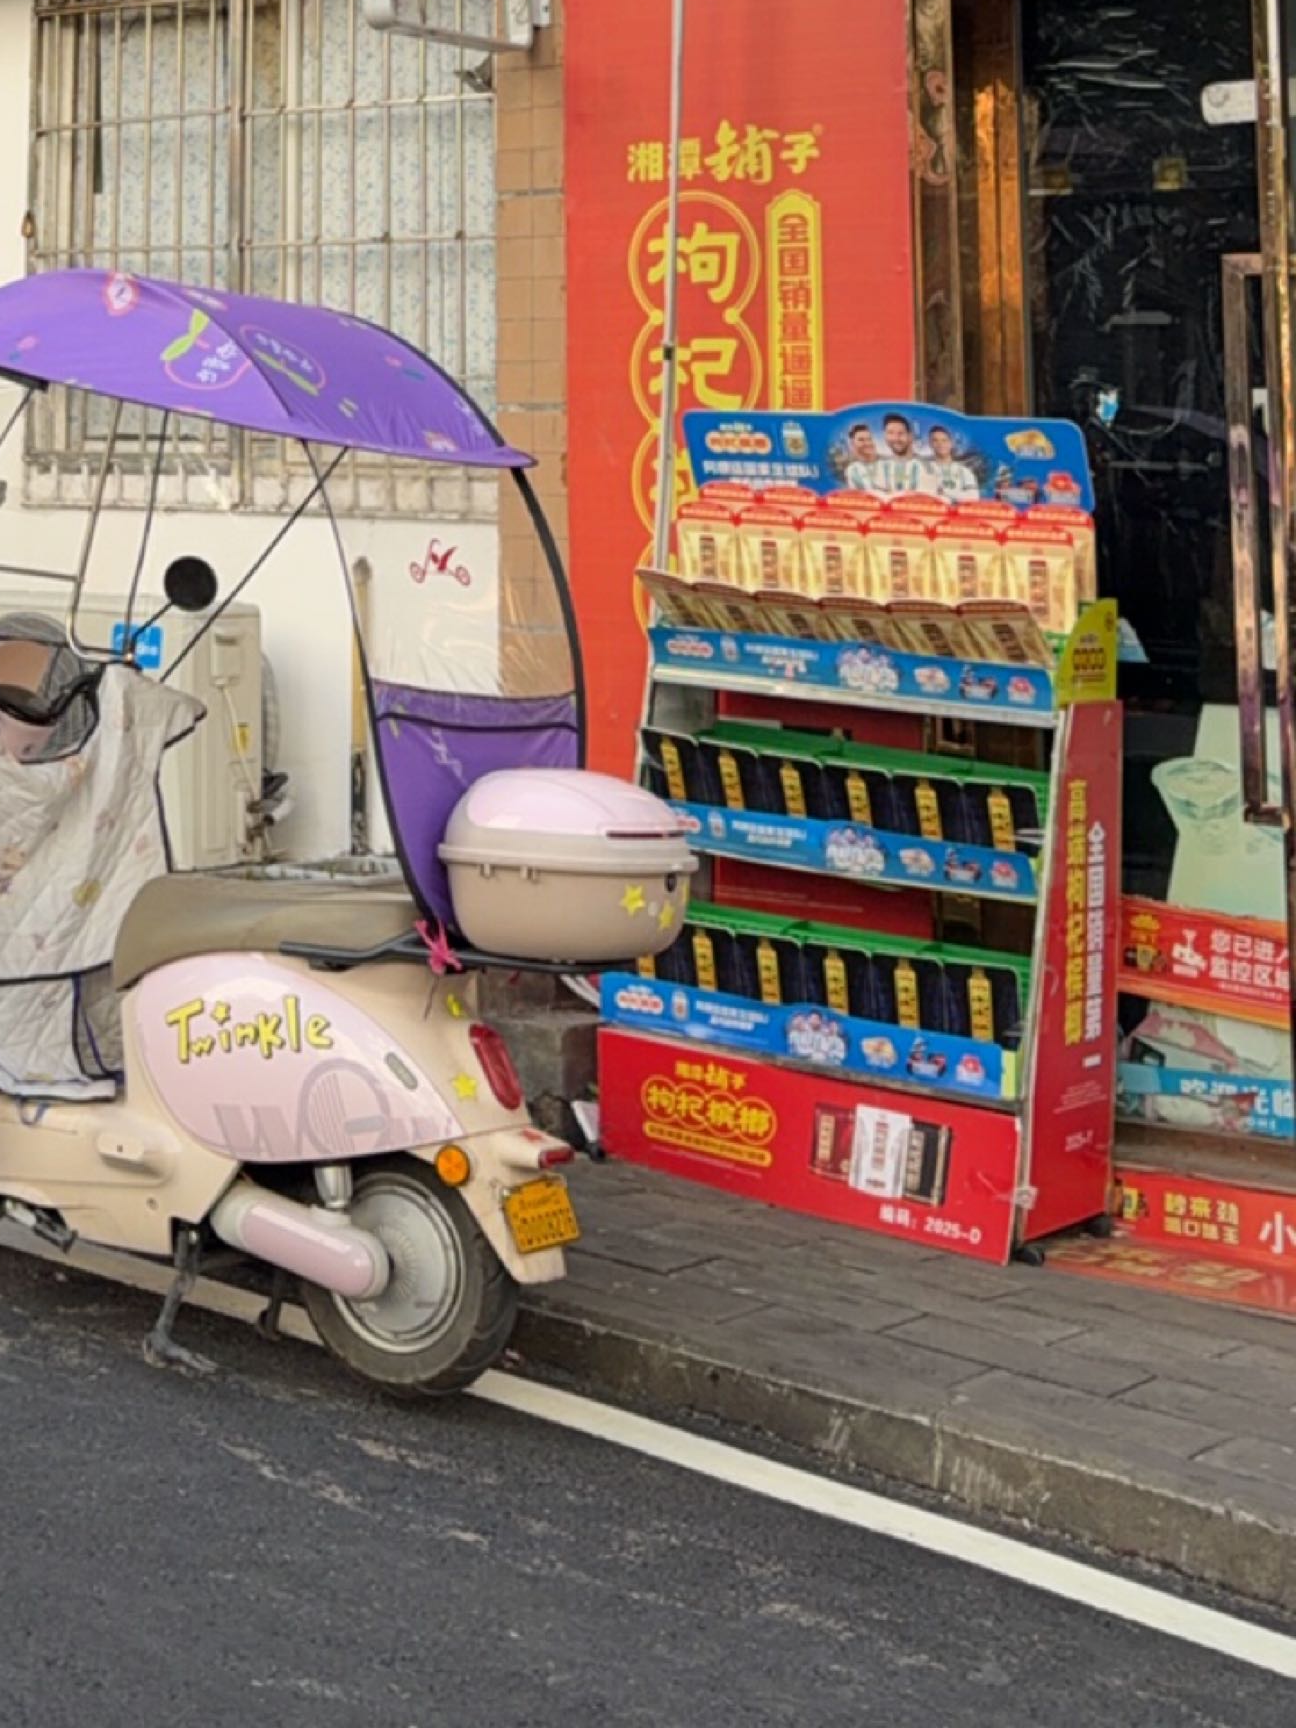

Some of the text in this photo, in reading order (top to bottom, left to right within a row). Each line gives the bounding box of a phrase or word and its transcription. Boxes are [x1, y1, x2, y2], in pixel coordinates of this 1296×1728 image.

[627, 119, 821, 185] 湘潭铺子
[647, 222, 742, 518] 枸杞
[165, 995, 335, 1064] Twinkle
